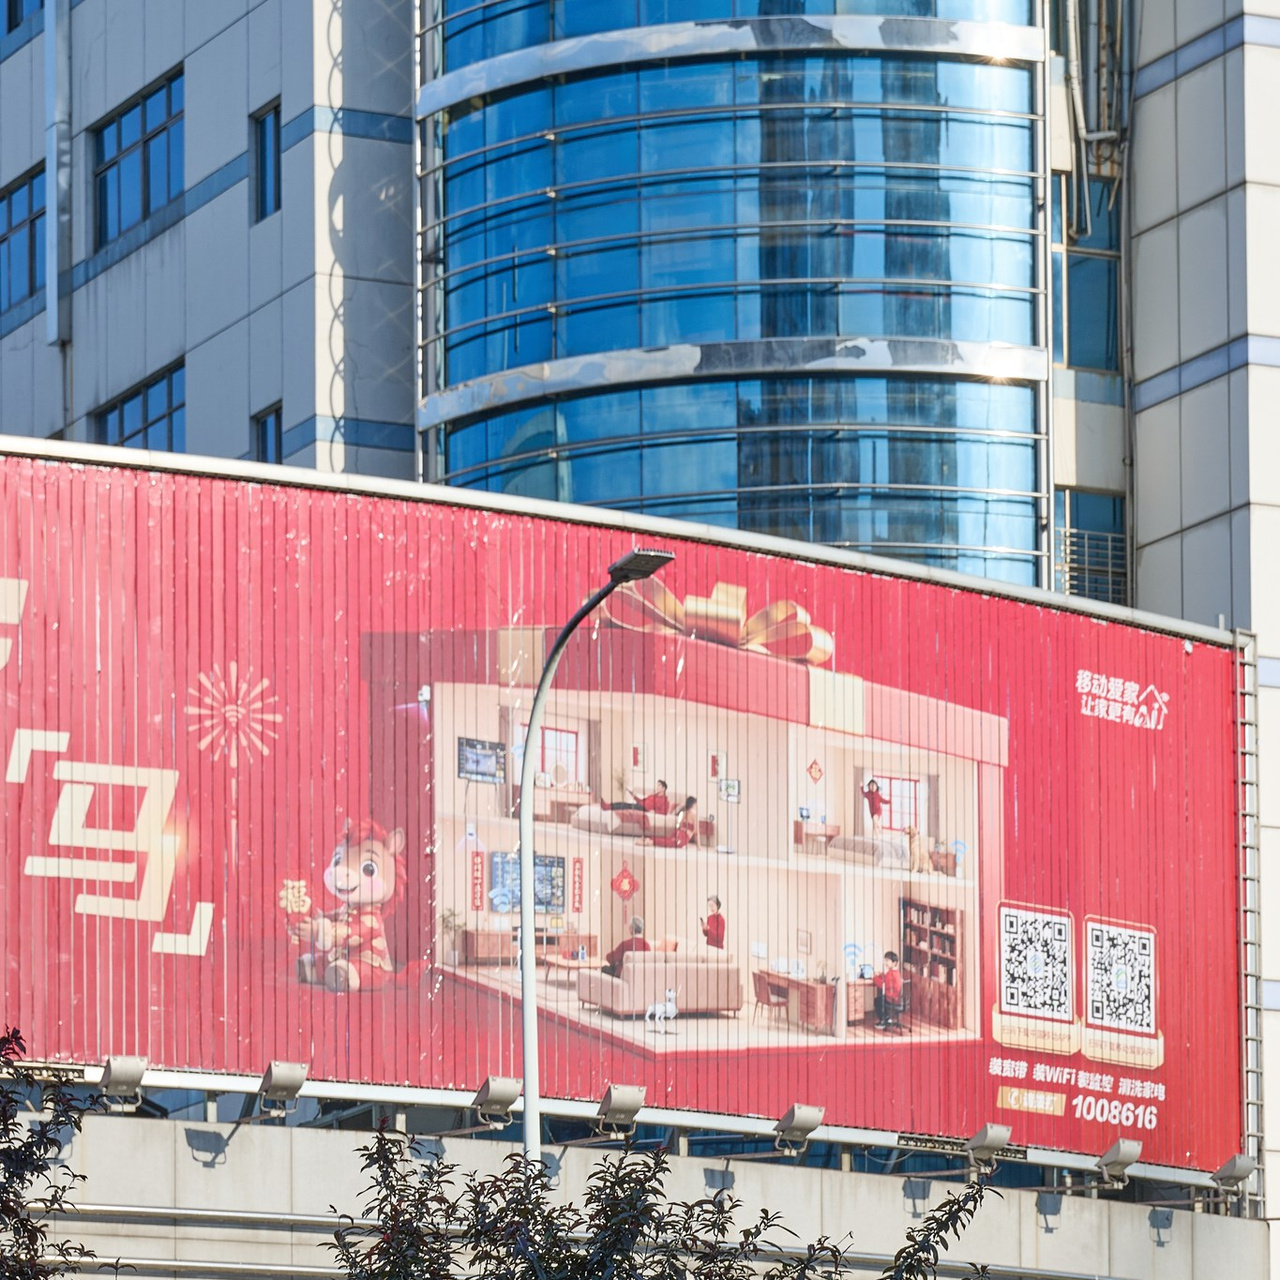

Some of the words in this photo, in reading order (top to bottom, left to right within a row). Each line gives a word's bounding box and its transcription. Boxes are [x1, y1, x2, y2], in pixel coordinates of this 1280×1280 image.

[1075, 669, 1140, 705] 移动爱家
[989, 1057, 1028, 1079] 装宽带
[1033, 1063, 1076, 1086] 装WiFi
[1118, 1078, 1166, 1101] 清洗家电
[1072, 1095, 1158, 1130] 1008616
